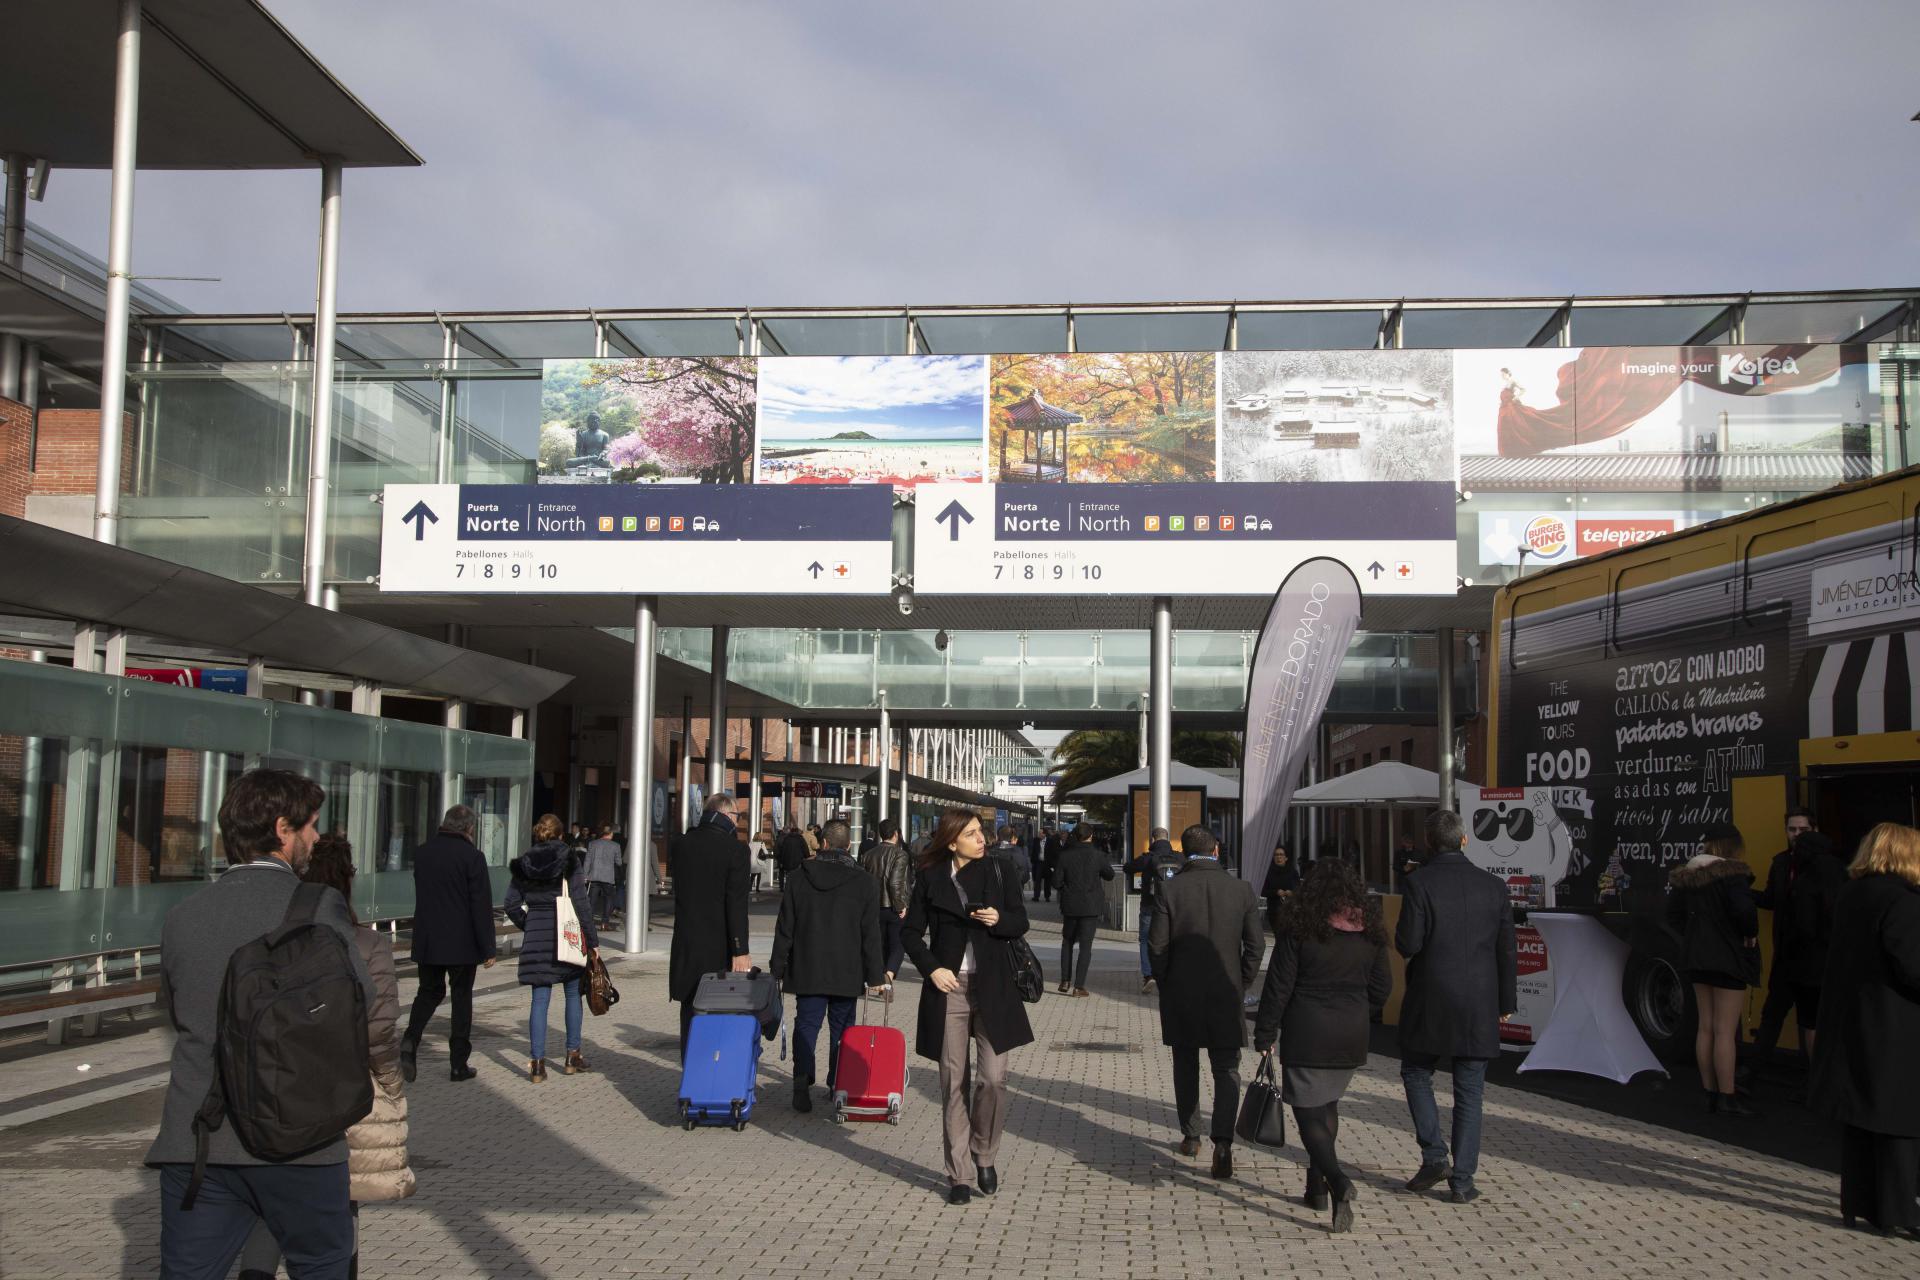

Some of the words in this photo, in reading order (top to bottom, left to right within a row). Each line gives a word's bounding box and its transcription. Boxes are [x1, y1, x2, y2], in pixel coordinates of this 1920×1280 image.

[1621, 362, 1676, 376] Imagine
[1680, 362, 1714, 377] your
[1720, 352, 1800, 386] Korea
[467, 503, 499, 512] Puerta
[538, 503, 577, 512] Entrance
[1004, 502, 1038, 512] Puerta
[1079, 502, 1120, 511] Entrance
[466, 516, 520, 532] Norte
[537, 516, 586, 532] North
[1004, 516, 1061, 532] Norte
[1079, 516, 1130, 532] North
[1529, 523, 1564, 539] BURGER
[1530, 531, 1566, 548] KING
[455, 549, 508, 559] Pabellones
[512, 550, 534, 559] Halls
[993, 550, 1049, 559] Pabellones
[1054, 550, 1076, 559] Halls
[455, 564, 465, 578] 7
[483, 564, 494, 579] 8
[511, 564, 521, 579] 9
[538, 564, 558, 579] 10
[993, 565, 1004, 580] 7
[1023, 565, 1034, 580] 8
[1052, 565, 1063, 580] 9
[1081, 565, 1102, 580] 10
[1817, 579, 1873, 606] JIMÉNEZ
[1836, 592, 1916, 613] AUTOCARES
[1281, 582, 1330, 677] DORADO
[1615, 658, 1682, 692] arroz
[1686, 654, 1714, 683] CON
[1716, 644, 1765, 678] ADOBO
[1281, 623, 1331, 742] AUTOCARES
[1549, 680, 1569, 698] THE
[1615, 691, 1670, 717] CALLOS
[1671, 698, 1680, 712] a
[1683, 692, 1696, 710] la
[1699, 681, 1767, 709] Madrileña
[1538, 700, 1580, 720] YELLOW
[1541, 722, 1575, 741] TOURS
[1615, 719, 1688, 752] patatas
[1691, 710, 1764, 738] bravas
[1526, 747, 1591, 783] FOOD
[1615, 749, 1693, 776] verduras
[1702, 736, 1765, 793] ATÚN
[1552, 788, 1581, 807] UCK
[1614, 778, 1670, 799] asadas
[1676, 780, 1697, 796] con
[1614, 804, 1655, 827] ricos
[1656, 806, 1674, 842] y
[1486, 866, 1505, 875] TAKE
[1507, 867, 1524, 875] ONE
[1516, 942, 1545, 955] LACE
